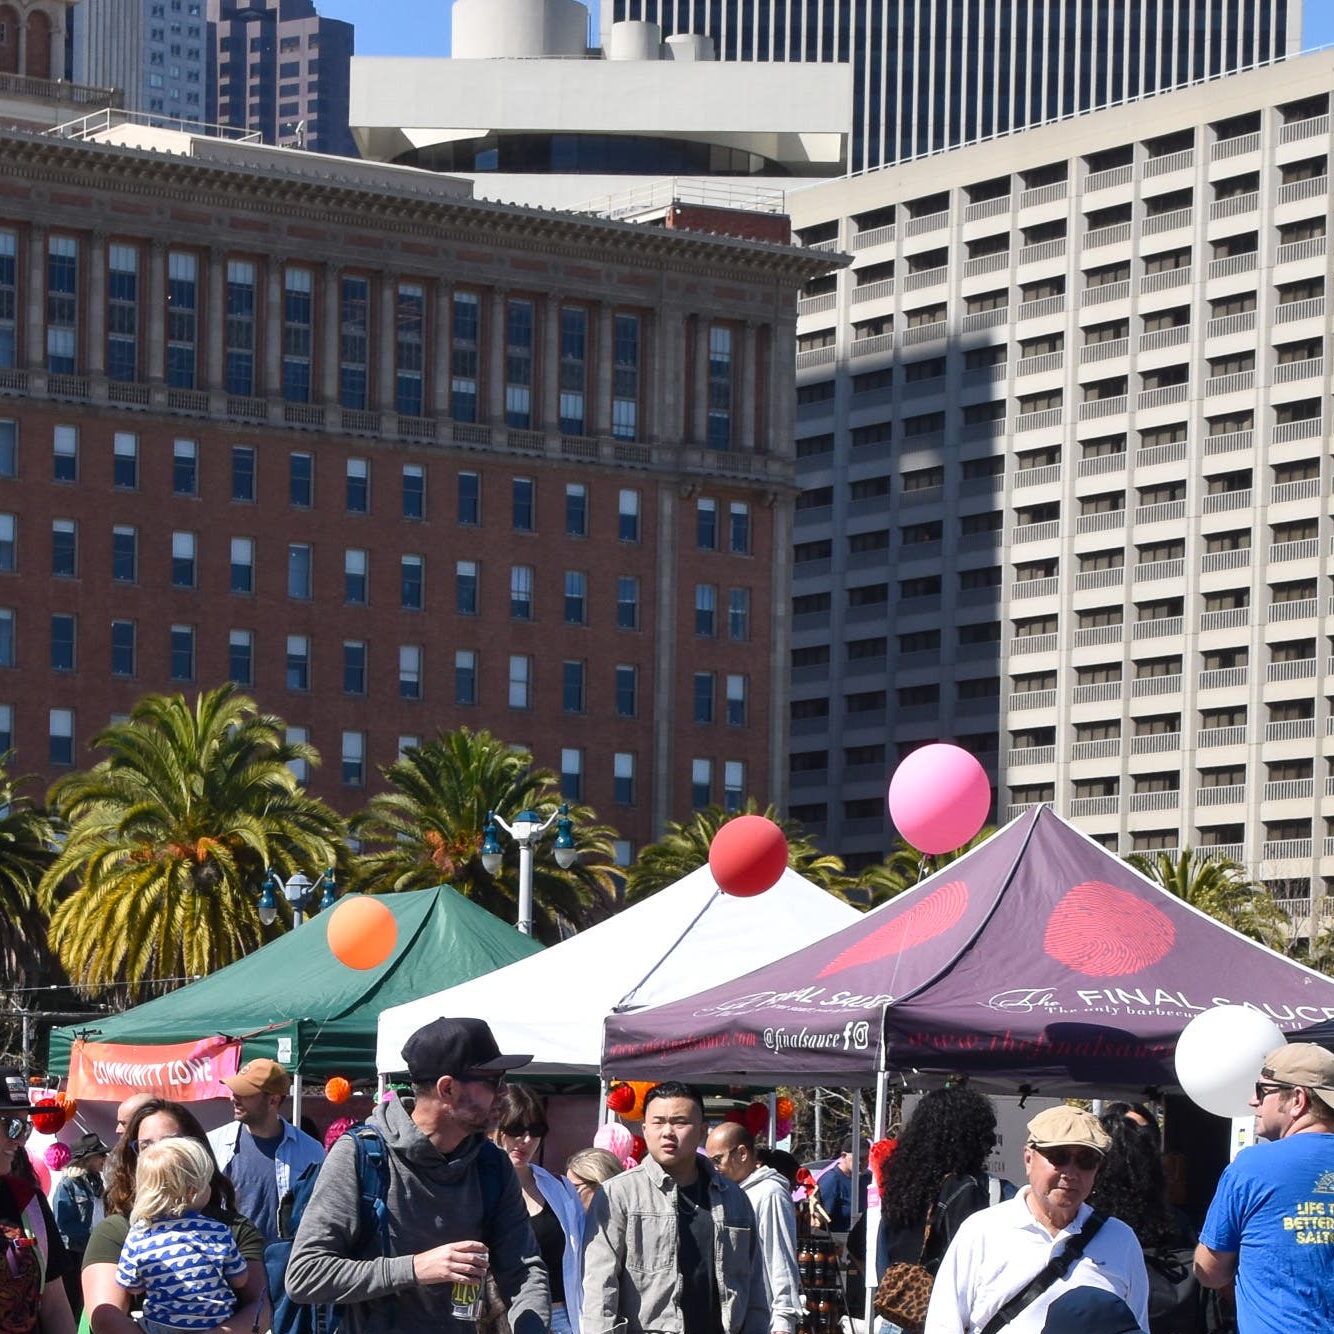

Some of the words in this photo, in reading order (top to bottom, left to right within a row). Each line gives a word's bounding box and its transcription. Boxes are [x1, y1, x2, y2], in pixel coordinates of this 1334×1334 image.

[1076, 988, 1208, 1011] FINAL
[763, 1026, 840, 1054] @finalsauce
[93, 1060, 167, 1086] COMMUNITY
[168, 1057, 213, 1086] ZONE
[1297, 1202, 1325, 1215] LIFE
[1283, 1216, 1334, 1230] BETTER
